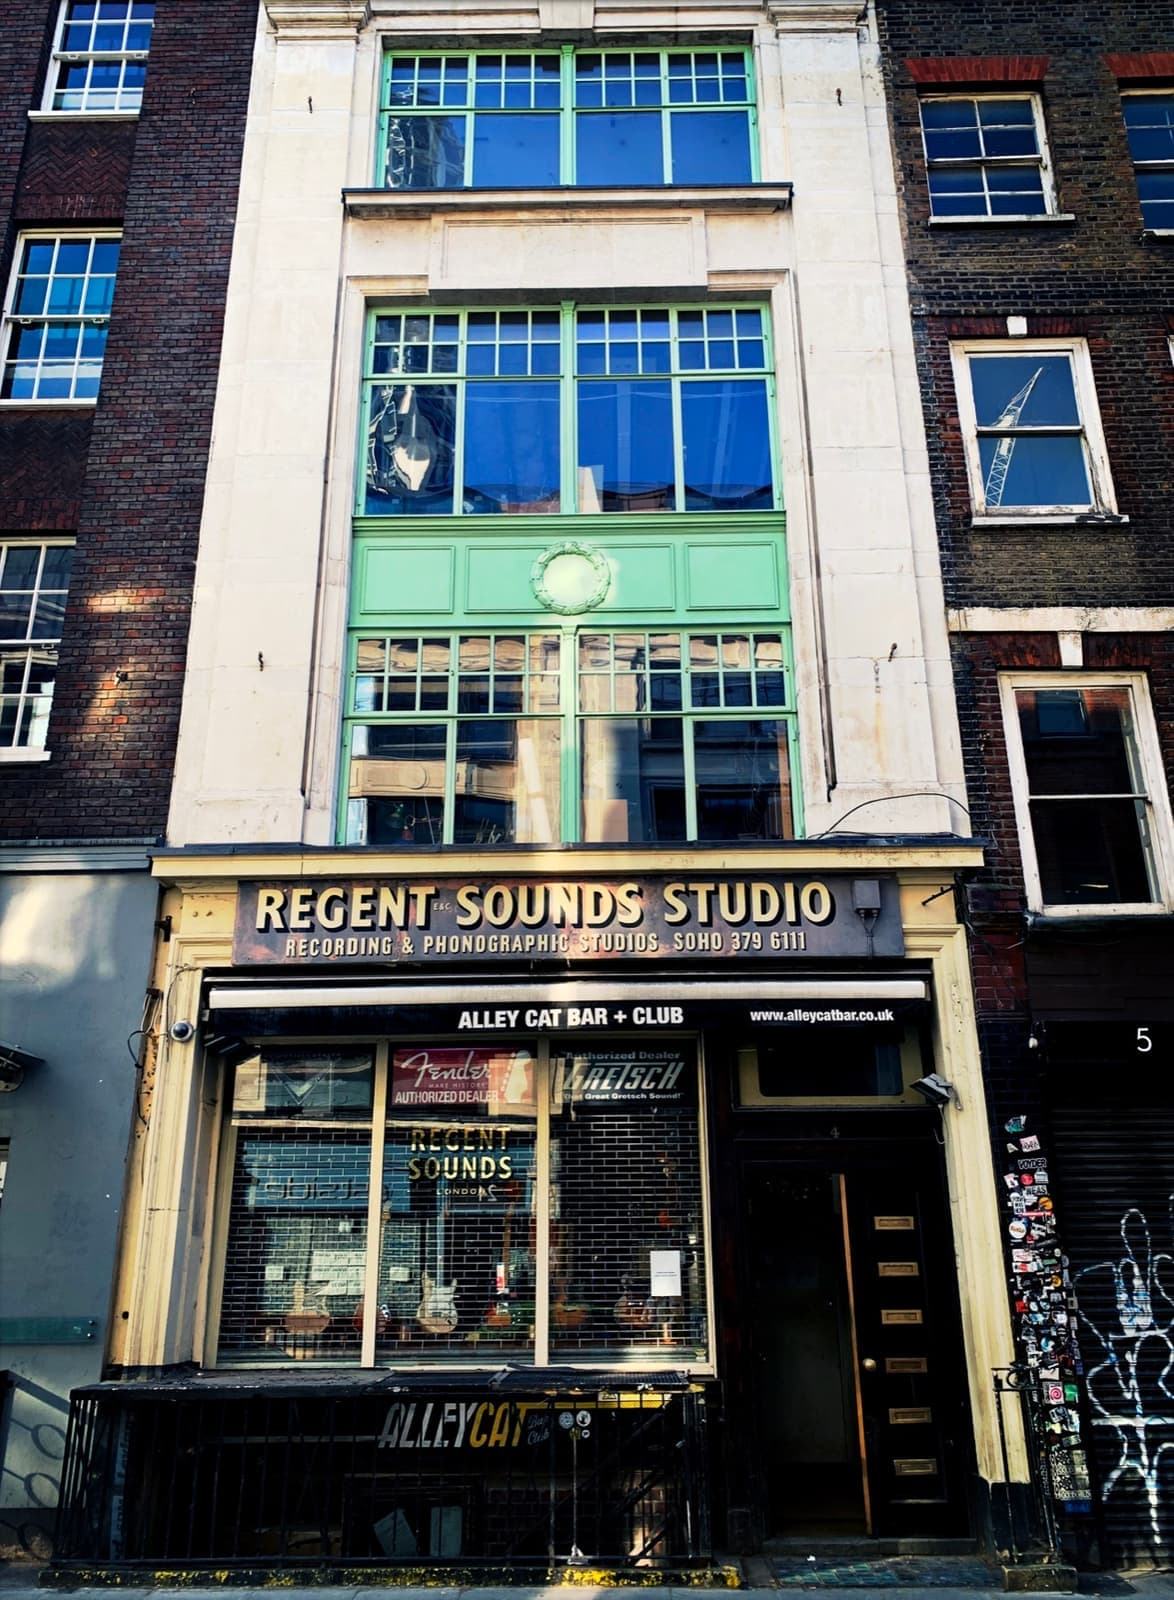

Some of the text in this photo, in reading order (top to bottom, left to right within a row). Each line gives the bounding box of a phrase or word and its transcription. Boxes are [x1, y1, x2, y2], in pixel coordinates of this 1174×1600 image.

[256, 881, 833, 930] REGENT SOUNDS STUDIO
[286, 931, 806, 957] RECORDING & PHONOGRAPHIC STUDIOS SOHO 379 6111
[458, 1006, 684, 1029] ALLEY CAT BAR + CLUB
[750, 1009, 894, 1024] www.alleycatbar.co.uk
[1136, 1027, 1152, 1052] 5
[640, 1051, 681, 1060] Dealer
[401, 1051, 492, 1088] Fender
[563, 1062, 685, 1090] GRETSCH
[395, 1089, 499, 1104] AUTHORIZED DEALER
[611, 1092, 648, 1100] Gretsch
[408, 1156, 513, 1179] SOUNDS
